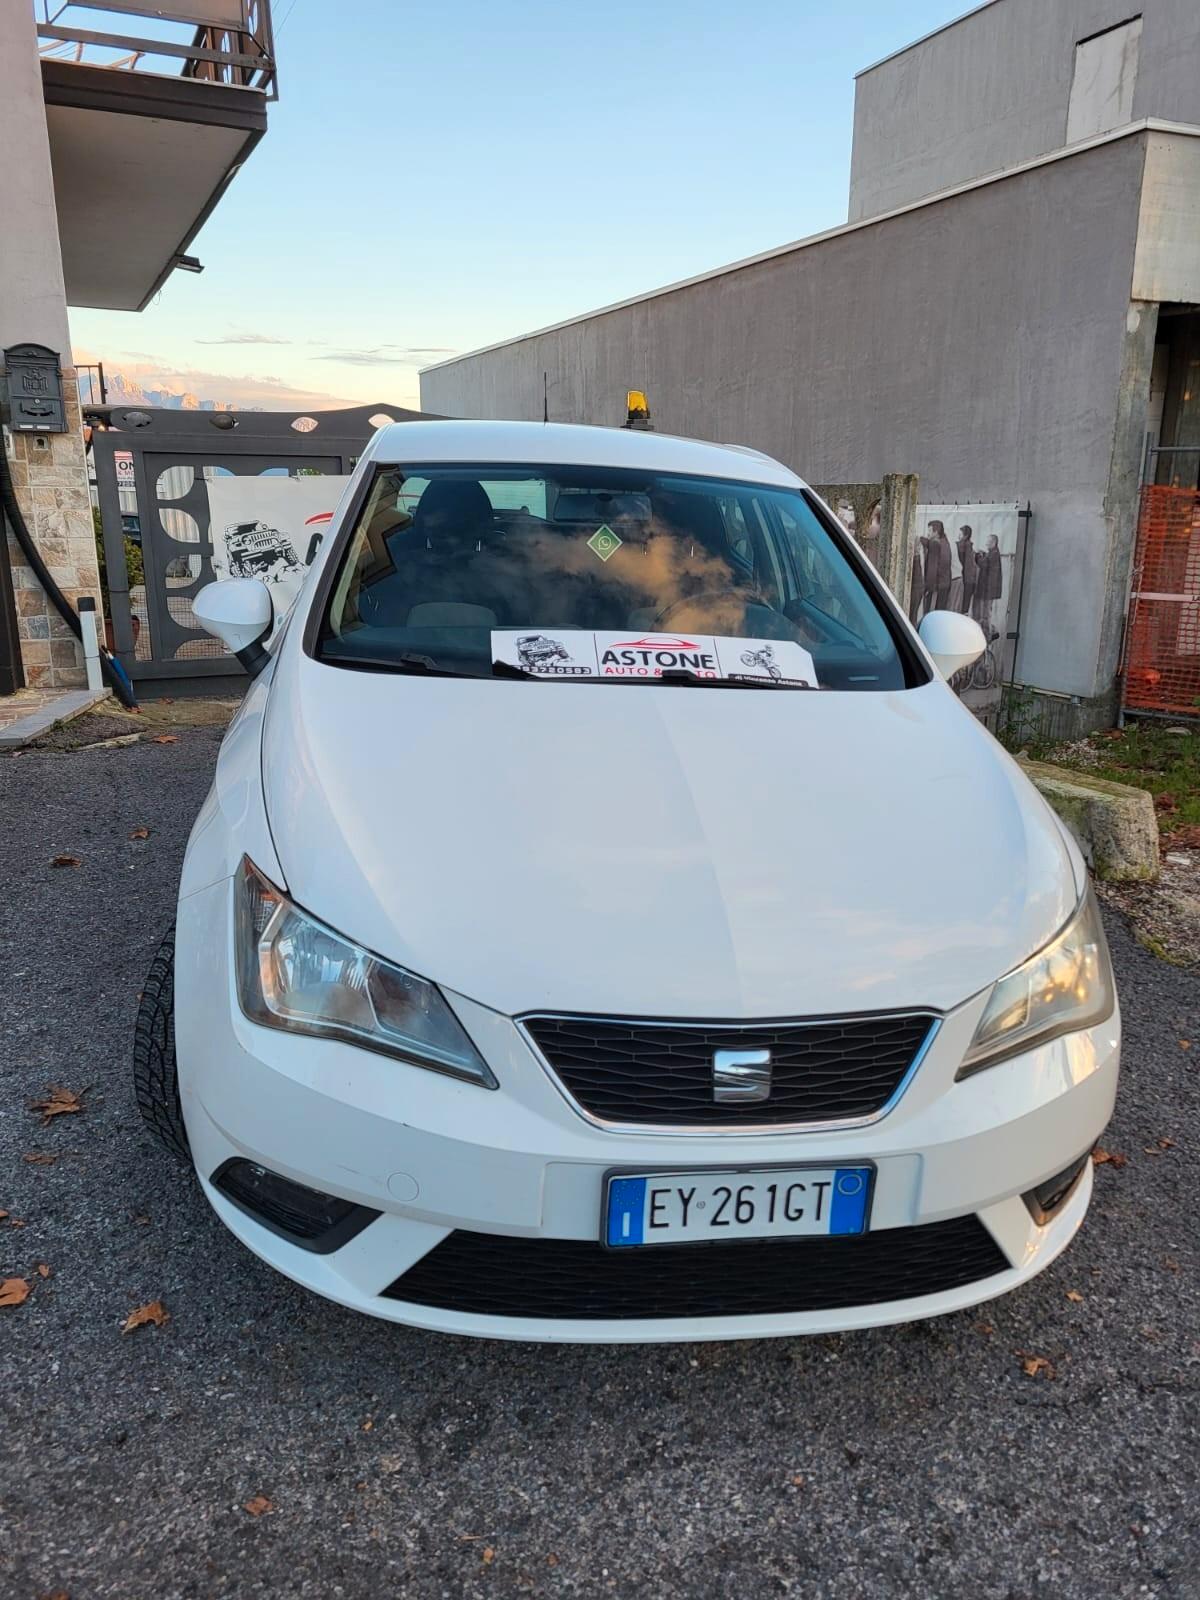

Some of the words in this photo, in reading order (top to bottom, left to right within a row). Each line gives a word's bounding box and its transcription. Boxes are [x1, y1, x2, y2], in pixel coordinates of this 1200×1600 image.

[602, 650, 716, 670] ASTONE
[604, 667, 648, 676] AUTO
[654, 668, 663, 676] &
[649, 1186, 697, 1229] EY
[709, 1181, 831, 1227] 261GT
